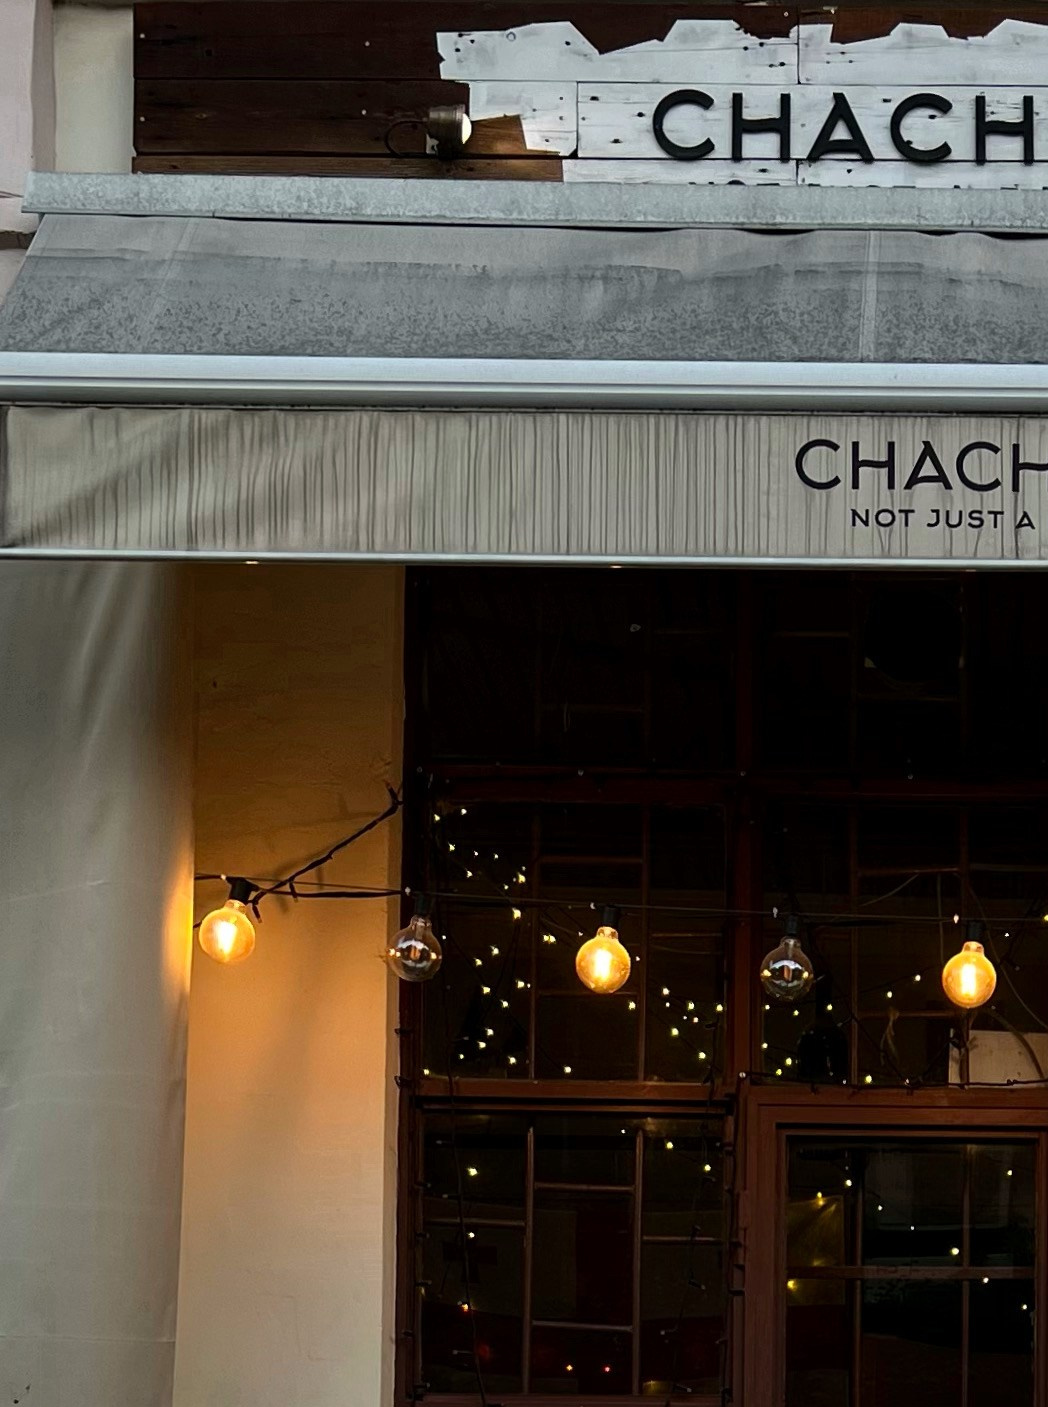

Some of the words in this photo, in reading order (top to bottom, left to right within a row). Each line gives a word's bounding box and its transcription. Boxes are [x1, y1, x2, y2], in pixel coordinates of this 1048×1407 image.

[850, 508, 916, 530] NOT
[925, 508, 1004, 532] JUST
[1014, 510, 1037, 531] A
